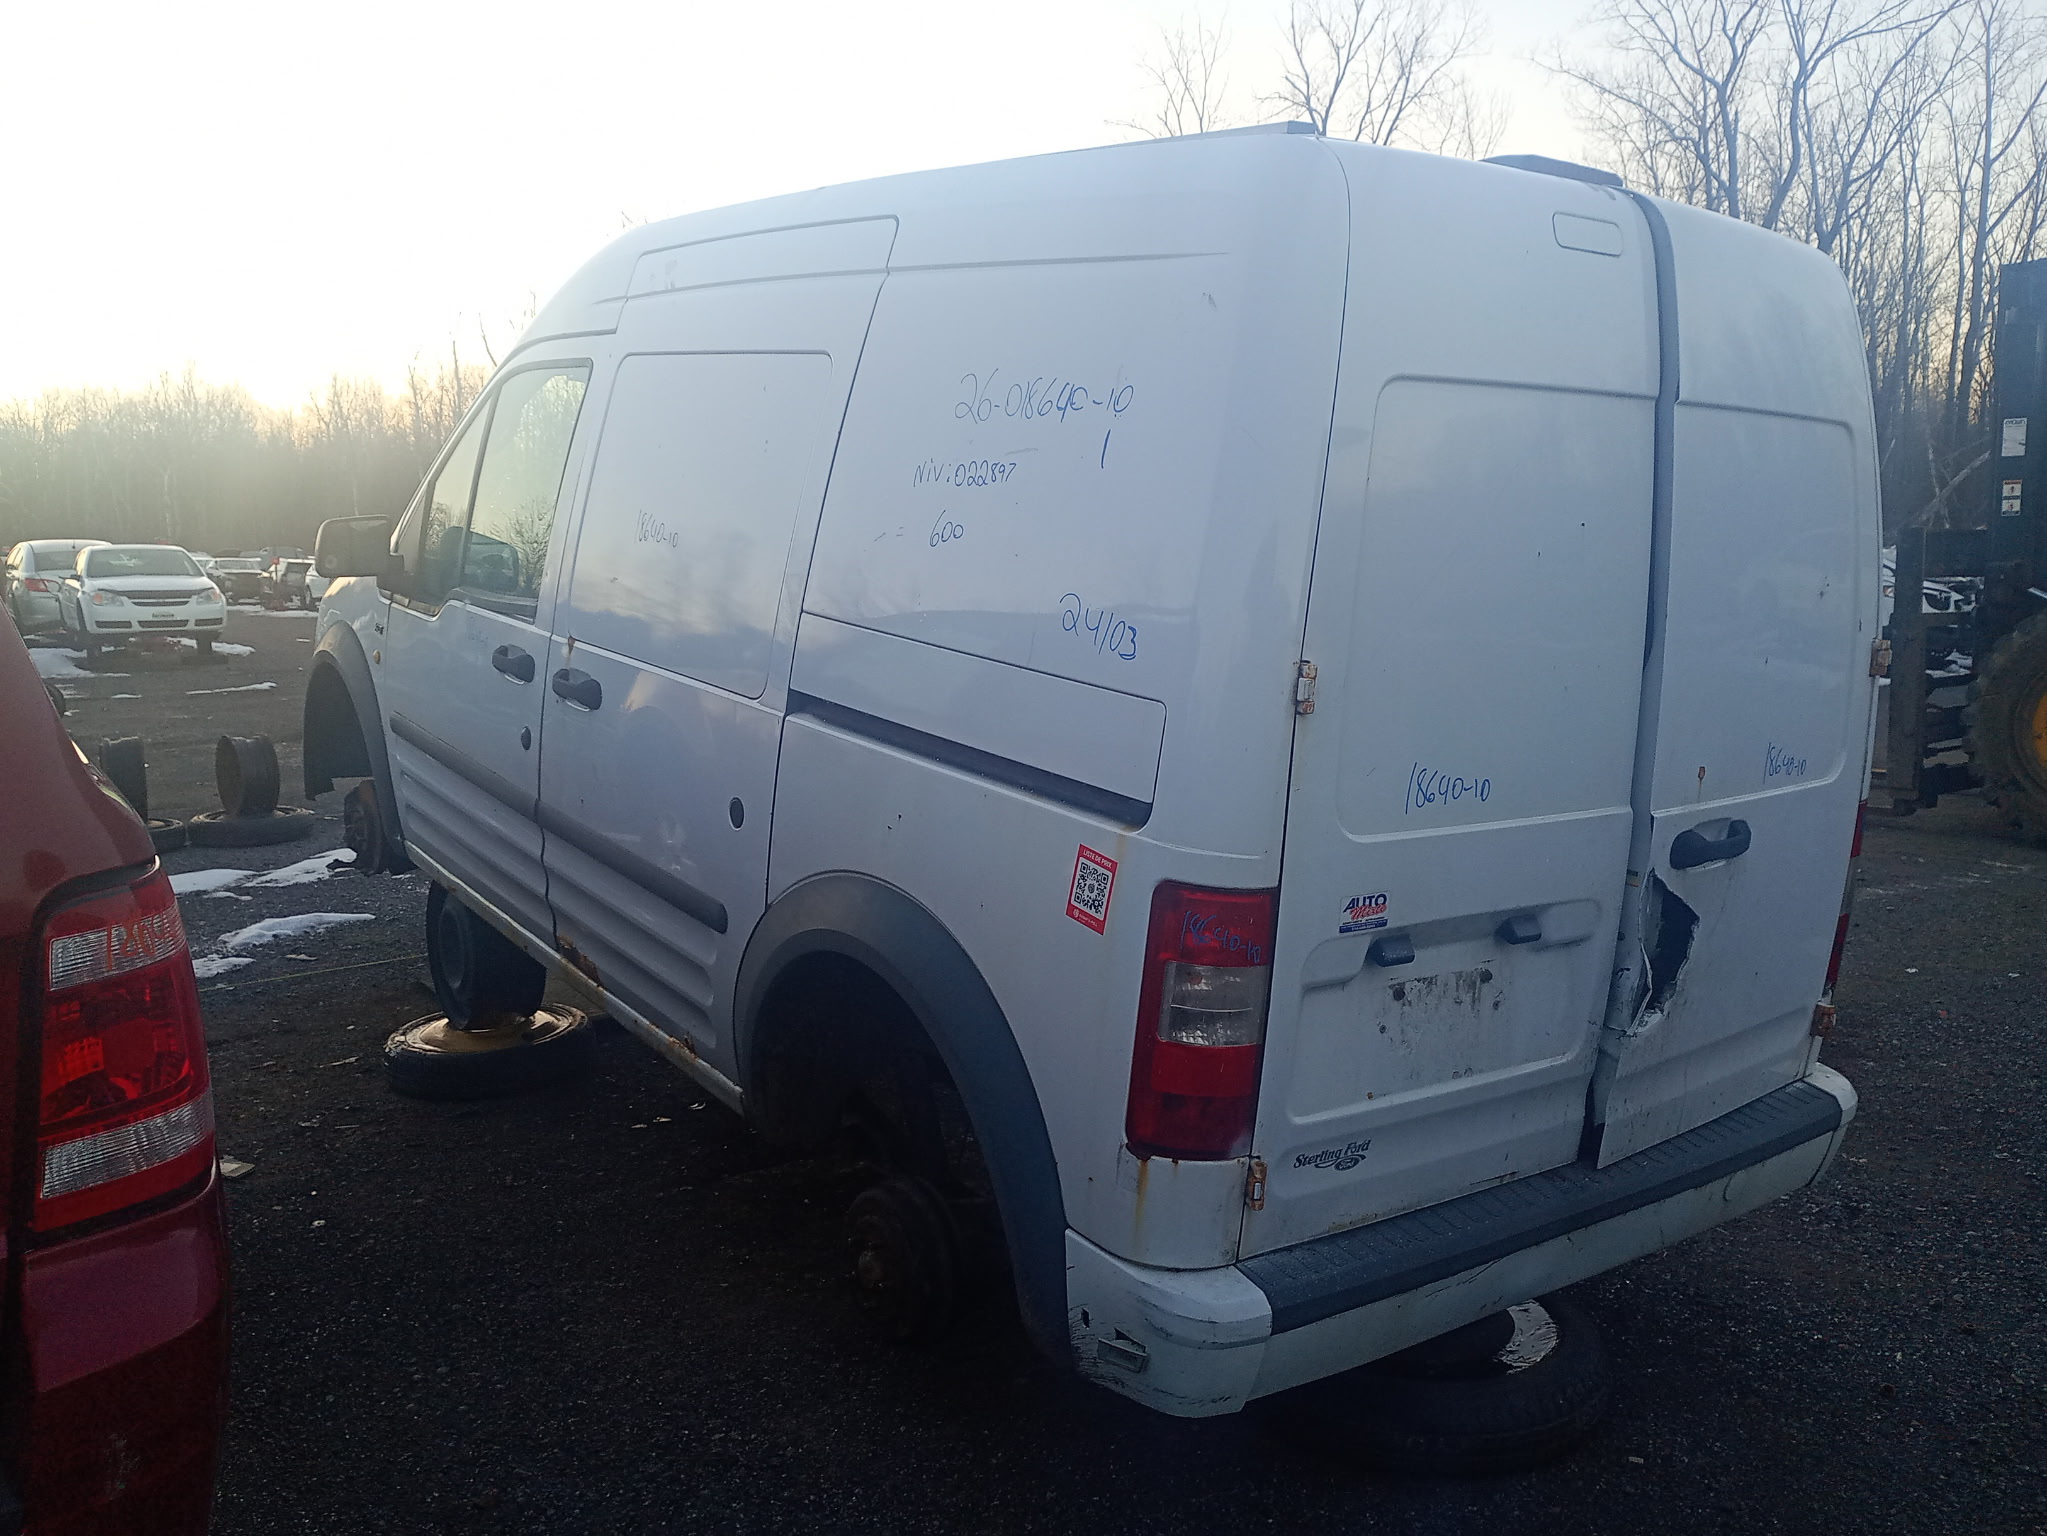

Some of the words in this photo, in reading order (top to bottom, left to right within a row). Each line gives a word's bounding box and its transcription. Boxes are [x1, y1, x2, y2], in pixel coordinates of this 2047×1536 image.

[929, 510, 964, 547] 600
[1059, 592, 1137, 660] 24/03
[1763, 742, 1807, 785] 18640-10
[1405, 762, 1491, 815] 18640-10
[1343, 893, 1388, 913] AUTO
[1293, 1148, 1343, 1168] Sterling
[1344, 1139, 1372, 1155] Ford
